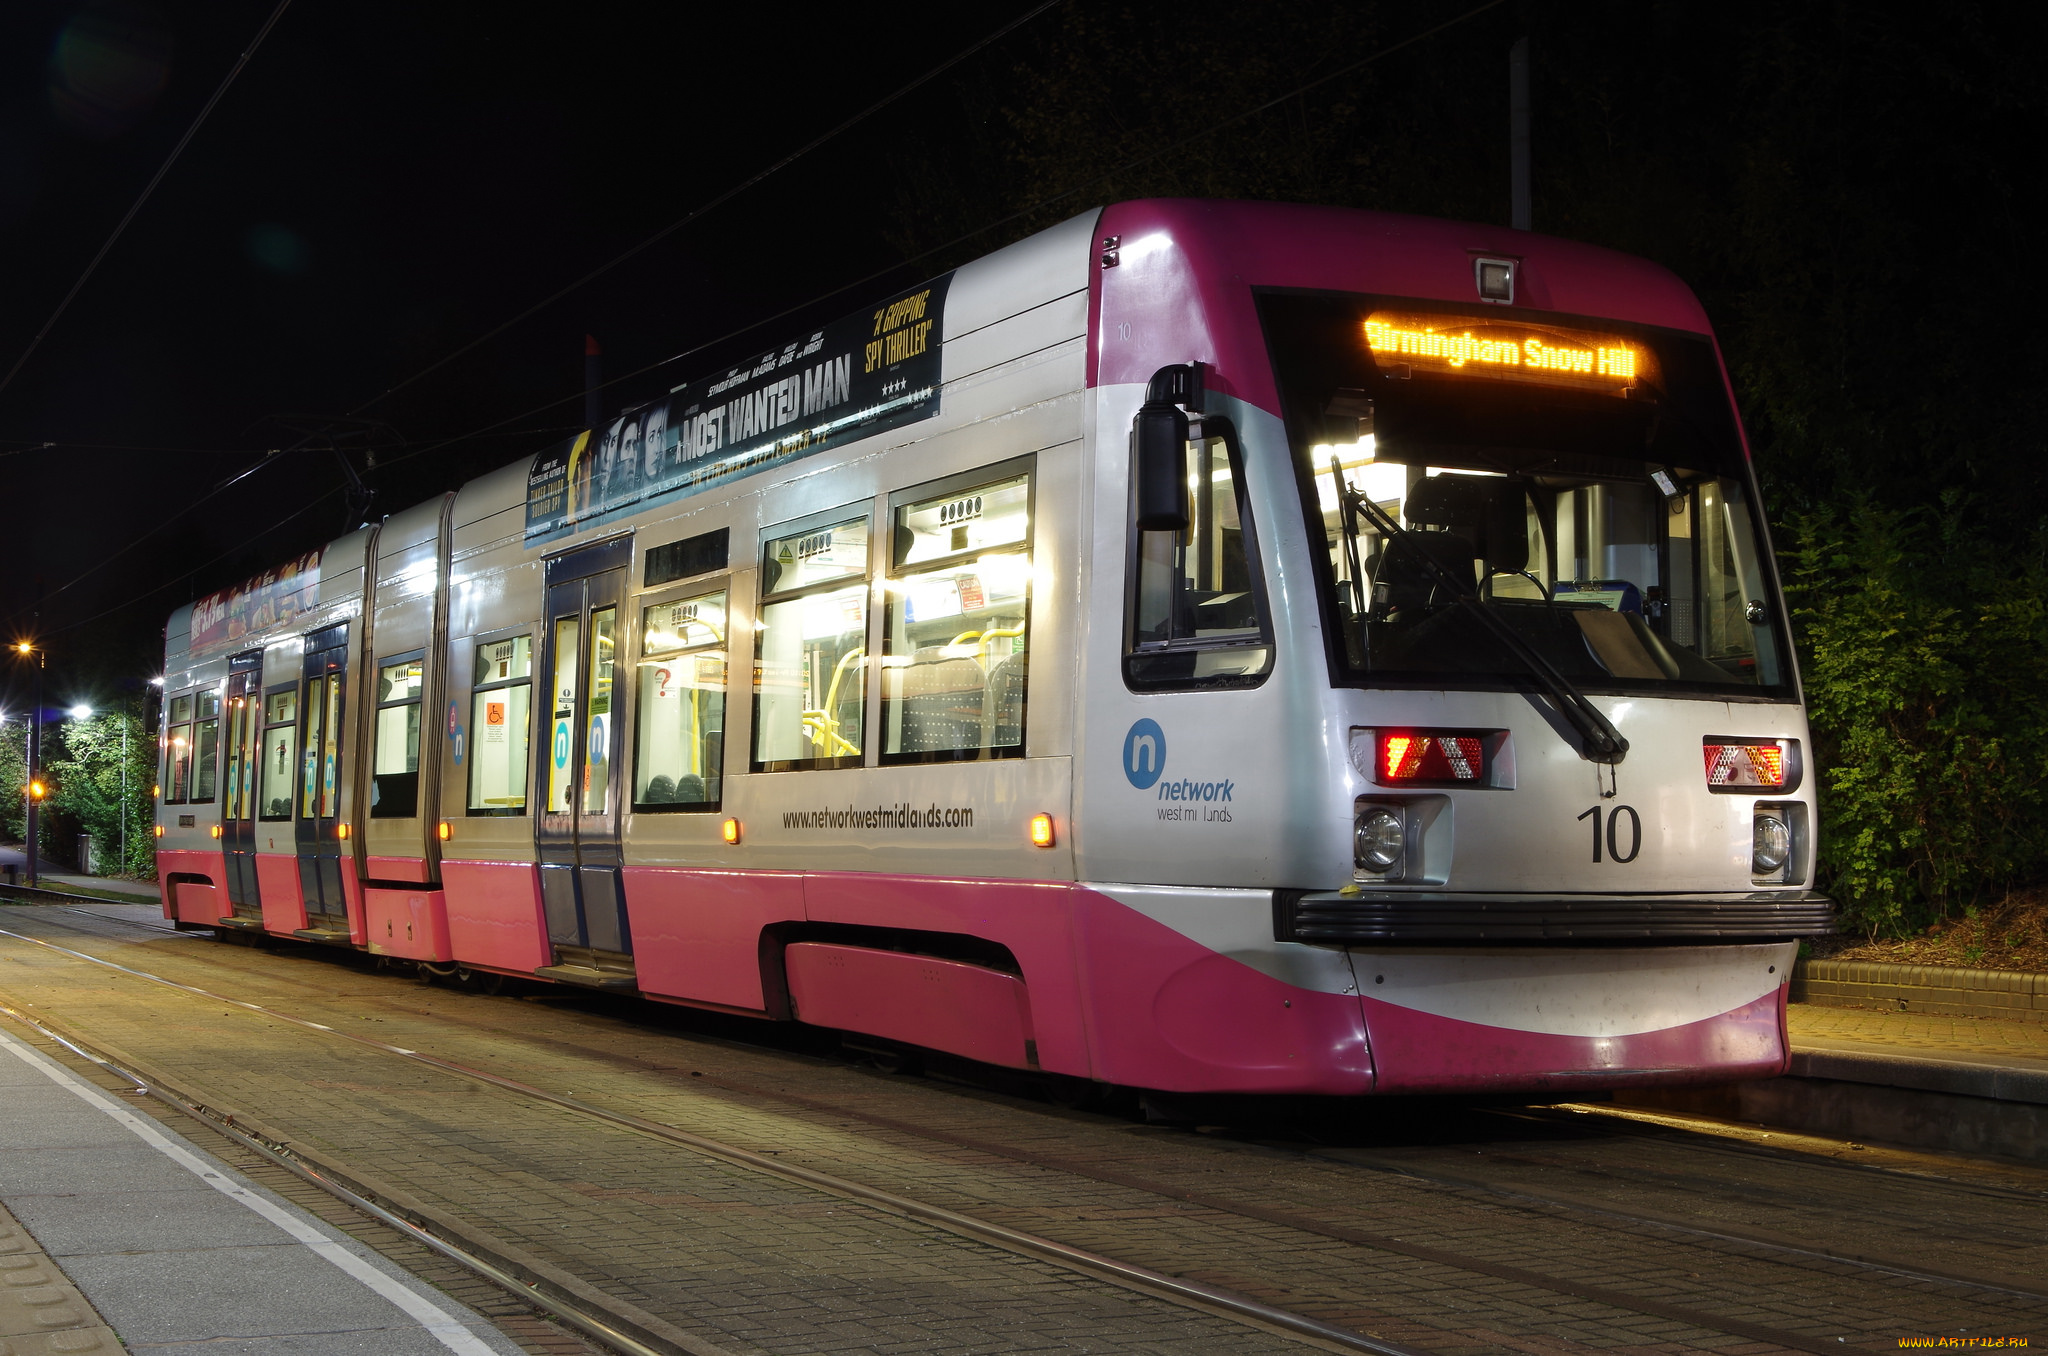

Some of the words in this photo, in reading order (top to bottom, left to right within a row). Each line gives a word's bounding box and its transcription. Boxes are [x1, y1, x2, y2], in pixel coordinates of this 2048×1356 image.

[883, 289, 931, 334] GRIPPING
[1118, 322, 1131, 341] 10
[1365, 320, 1519, 368] Birmingham
[1524, 339, 1593, 373] Snow
[1598, 347, 1635, 377] Hill
[865, 338, 884, 374] SPY
[682, 404, 726, 463] MOST
[728, 373, 801, 445] WANTED
[803, 352, 851, 417] MAN
[1158, 778, 1235, 802] network
[783, 802, 974, 829] www.networkwestmidlands.com
[1157, 804, 1182, 821] west
[1184, 805, 1233, 823] milands
[1577, 805, 1642, 863] 10
